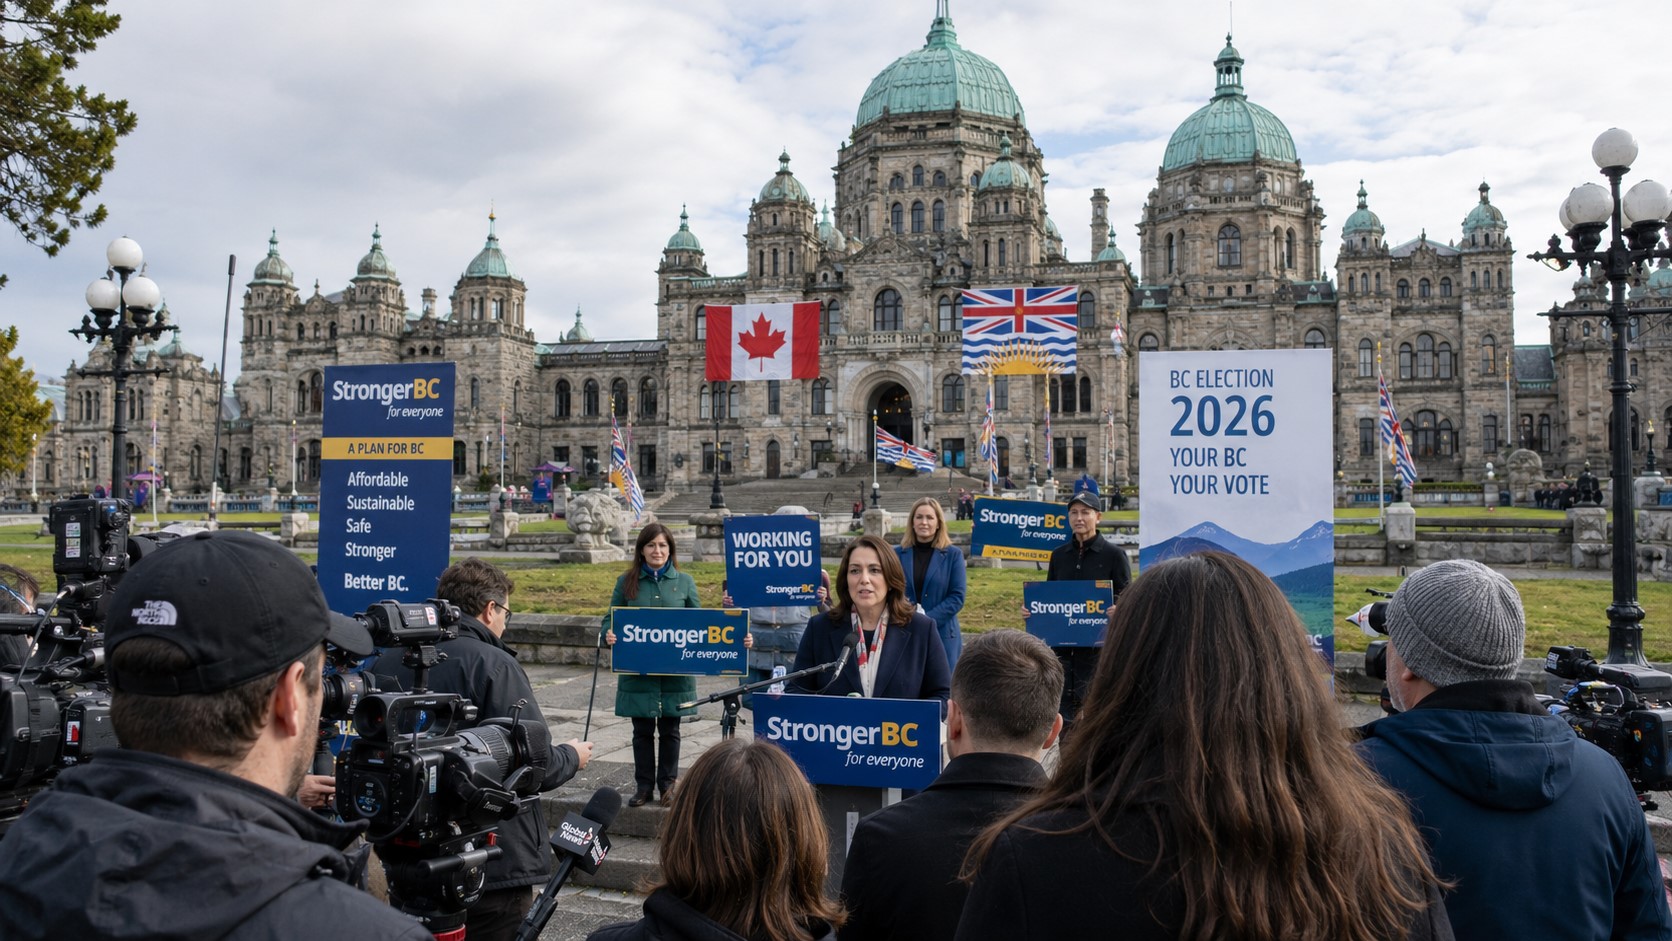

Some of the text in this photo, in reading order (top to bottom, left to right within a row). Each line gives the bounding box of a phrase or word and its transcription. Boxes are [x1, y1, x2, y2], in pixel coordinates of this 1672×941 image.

[1170, 369, 1274, 388] BC ELECTION
[332, 378, 441, 406] StrongerBC
[386, 405, 444, 420] for everyone
[1170, 395, 1276, 437] 2026
[347, 443, 424, 454] A PLAN FOR BC
[1170, 447, 1247, 467] YOUR BC
[347, 472, 409, 487] Affordable
[1170, 475, 1269, 494] YOUR VOTE
[346, 495, 415, 511] Sustainable
[346, 518, 372, 533] Safe
[980, 508, 1066, 529] StrongerBC
[732, 531, 812, 548] WORKING
[1021, 529, 1033, 538] for
[345, 541, 397, 562] Stronger
[734, 550, 813, 568] FOR YOU
[344, 573, 409, 592] Better BC.
[765, 584, 815, 596] StrongerBC
[1031, 600, 1105, 617] StrongerBC
[622, 624, 735, 648] StrongerBC
[681, 648, 739, 661] for everyone
[767, 716, 919, 750] StrongerBC
[845, 751, 925, 771] for everyone
